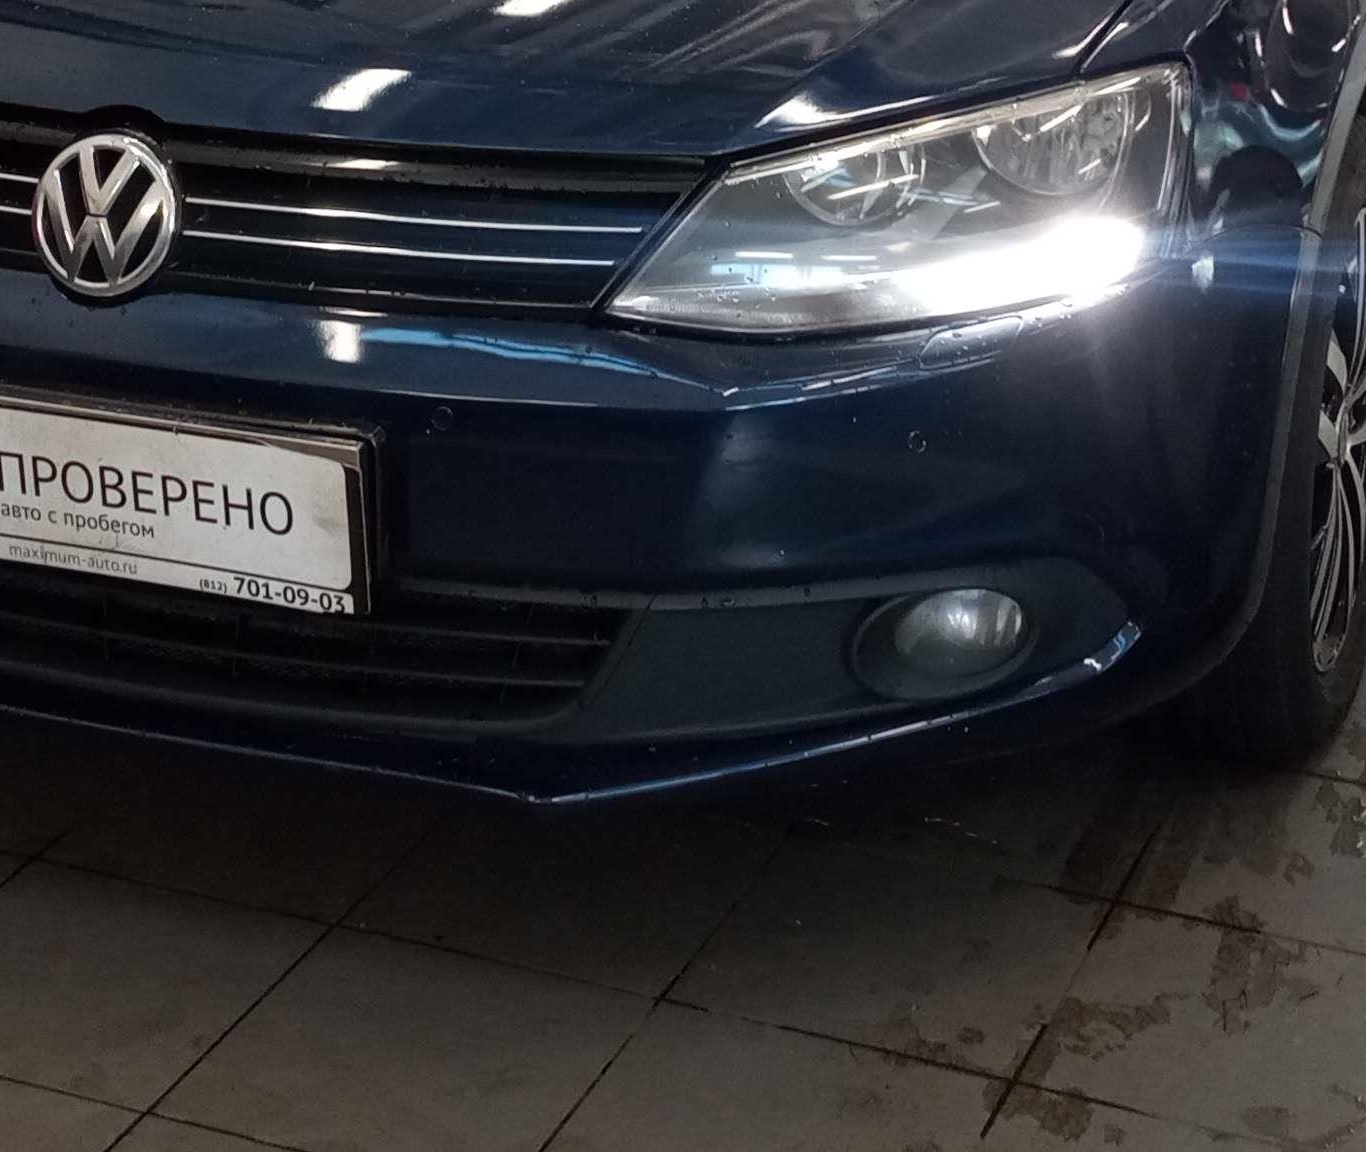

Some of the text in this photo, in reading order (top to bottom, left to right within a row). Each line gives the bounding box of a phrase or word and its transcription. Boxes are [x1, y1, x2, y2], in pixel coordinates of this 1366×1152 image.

[1, 501, 156, 539] авто с пробегом
[8, 543, 138, 576] maximum-auto.ru
[199, 577, 346, 614] (812) 701-09-03
